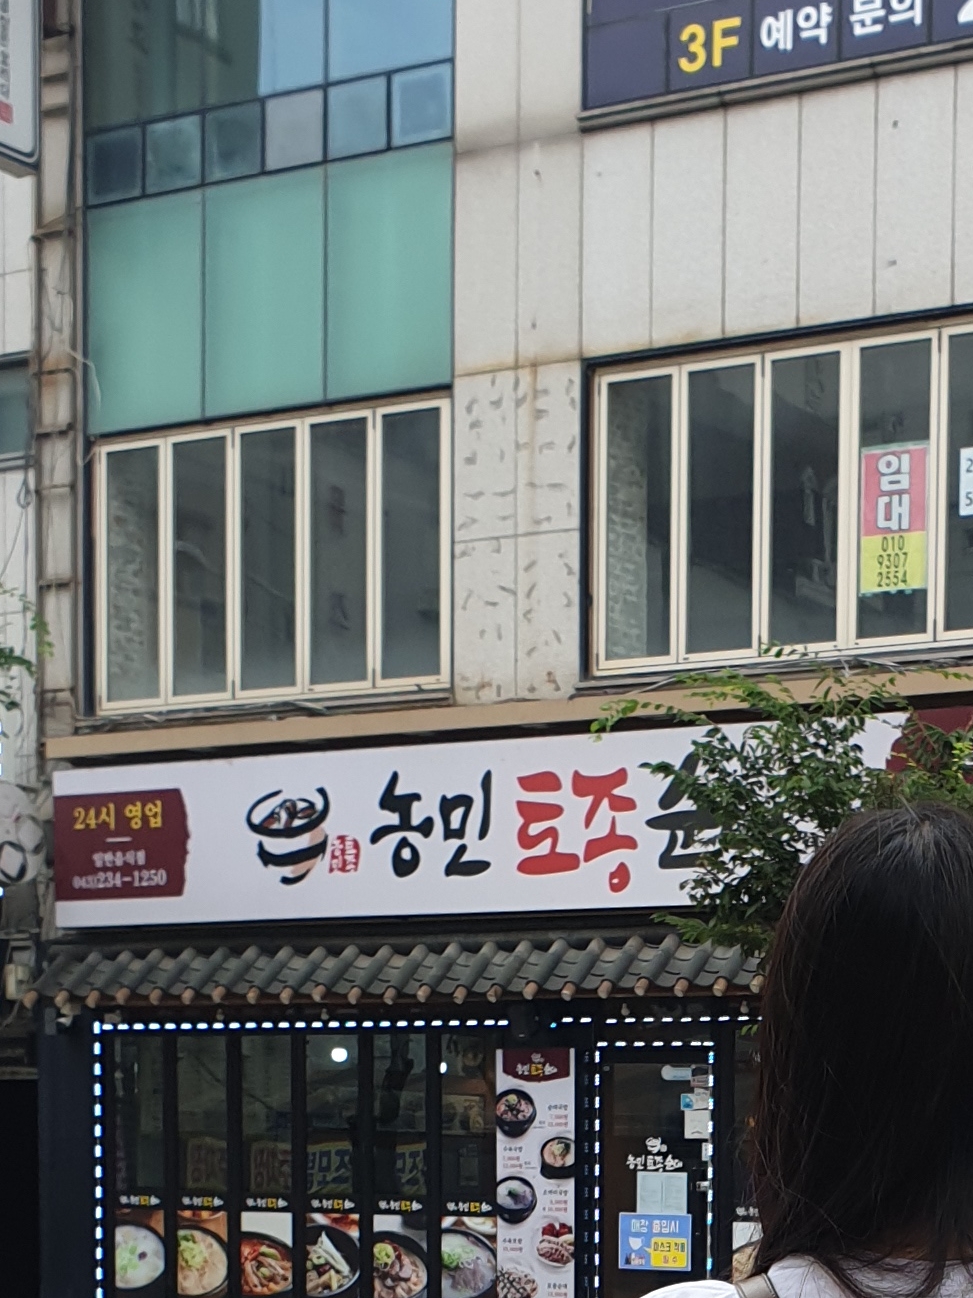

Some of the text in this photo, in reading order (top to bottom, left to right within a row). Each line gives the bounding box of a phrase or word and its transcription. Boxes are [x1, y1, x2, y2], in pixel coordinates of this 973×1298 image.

[677, 17, 741, 73] 3F
[759, 9, 832, 52] 예약
[849, 0, 923, 37] 문의
[876, 452, 911, 532] 임대
[881, 535, 905, 552] 010
[876, 552, 909, 569] 9307
[876, 570, 908, 587] 2554
[73, 800, 163, 831] 24시 영업
